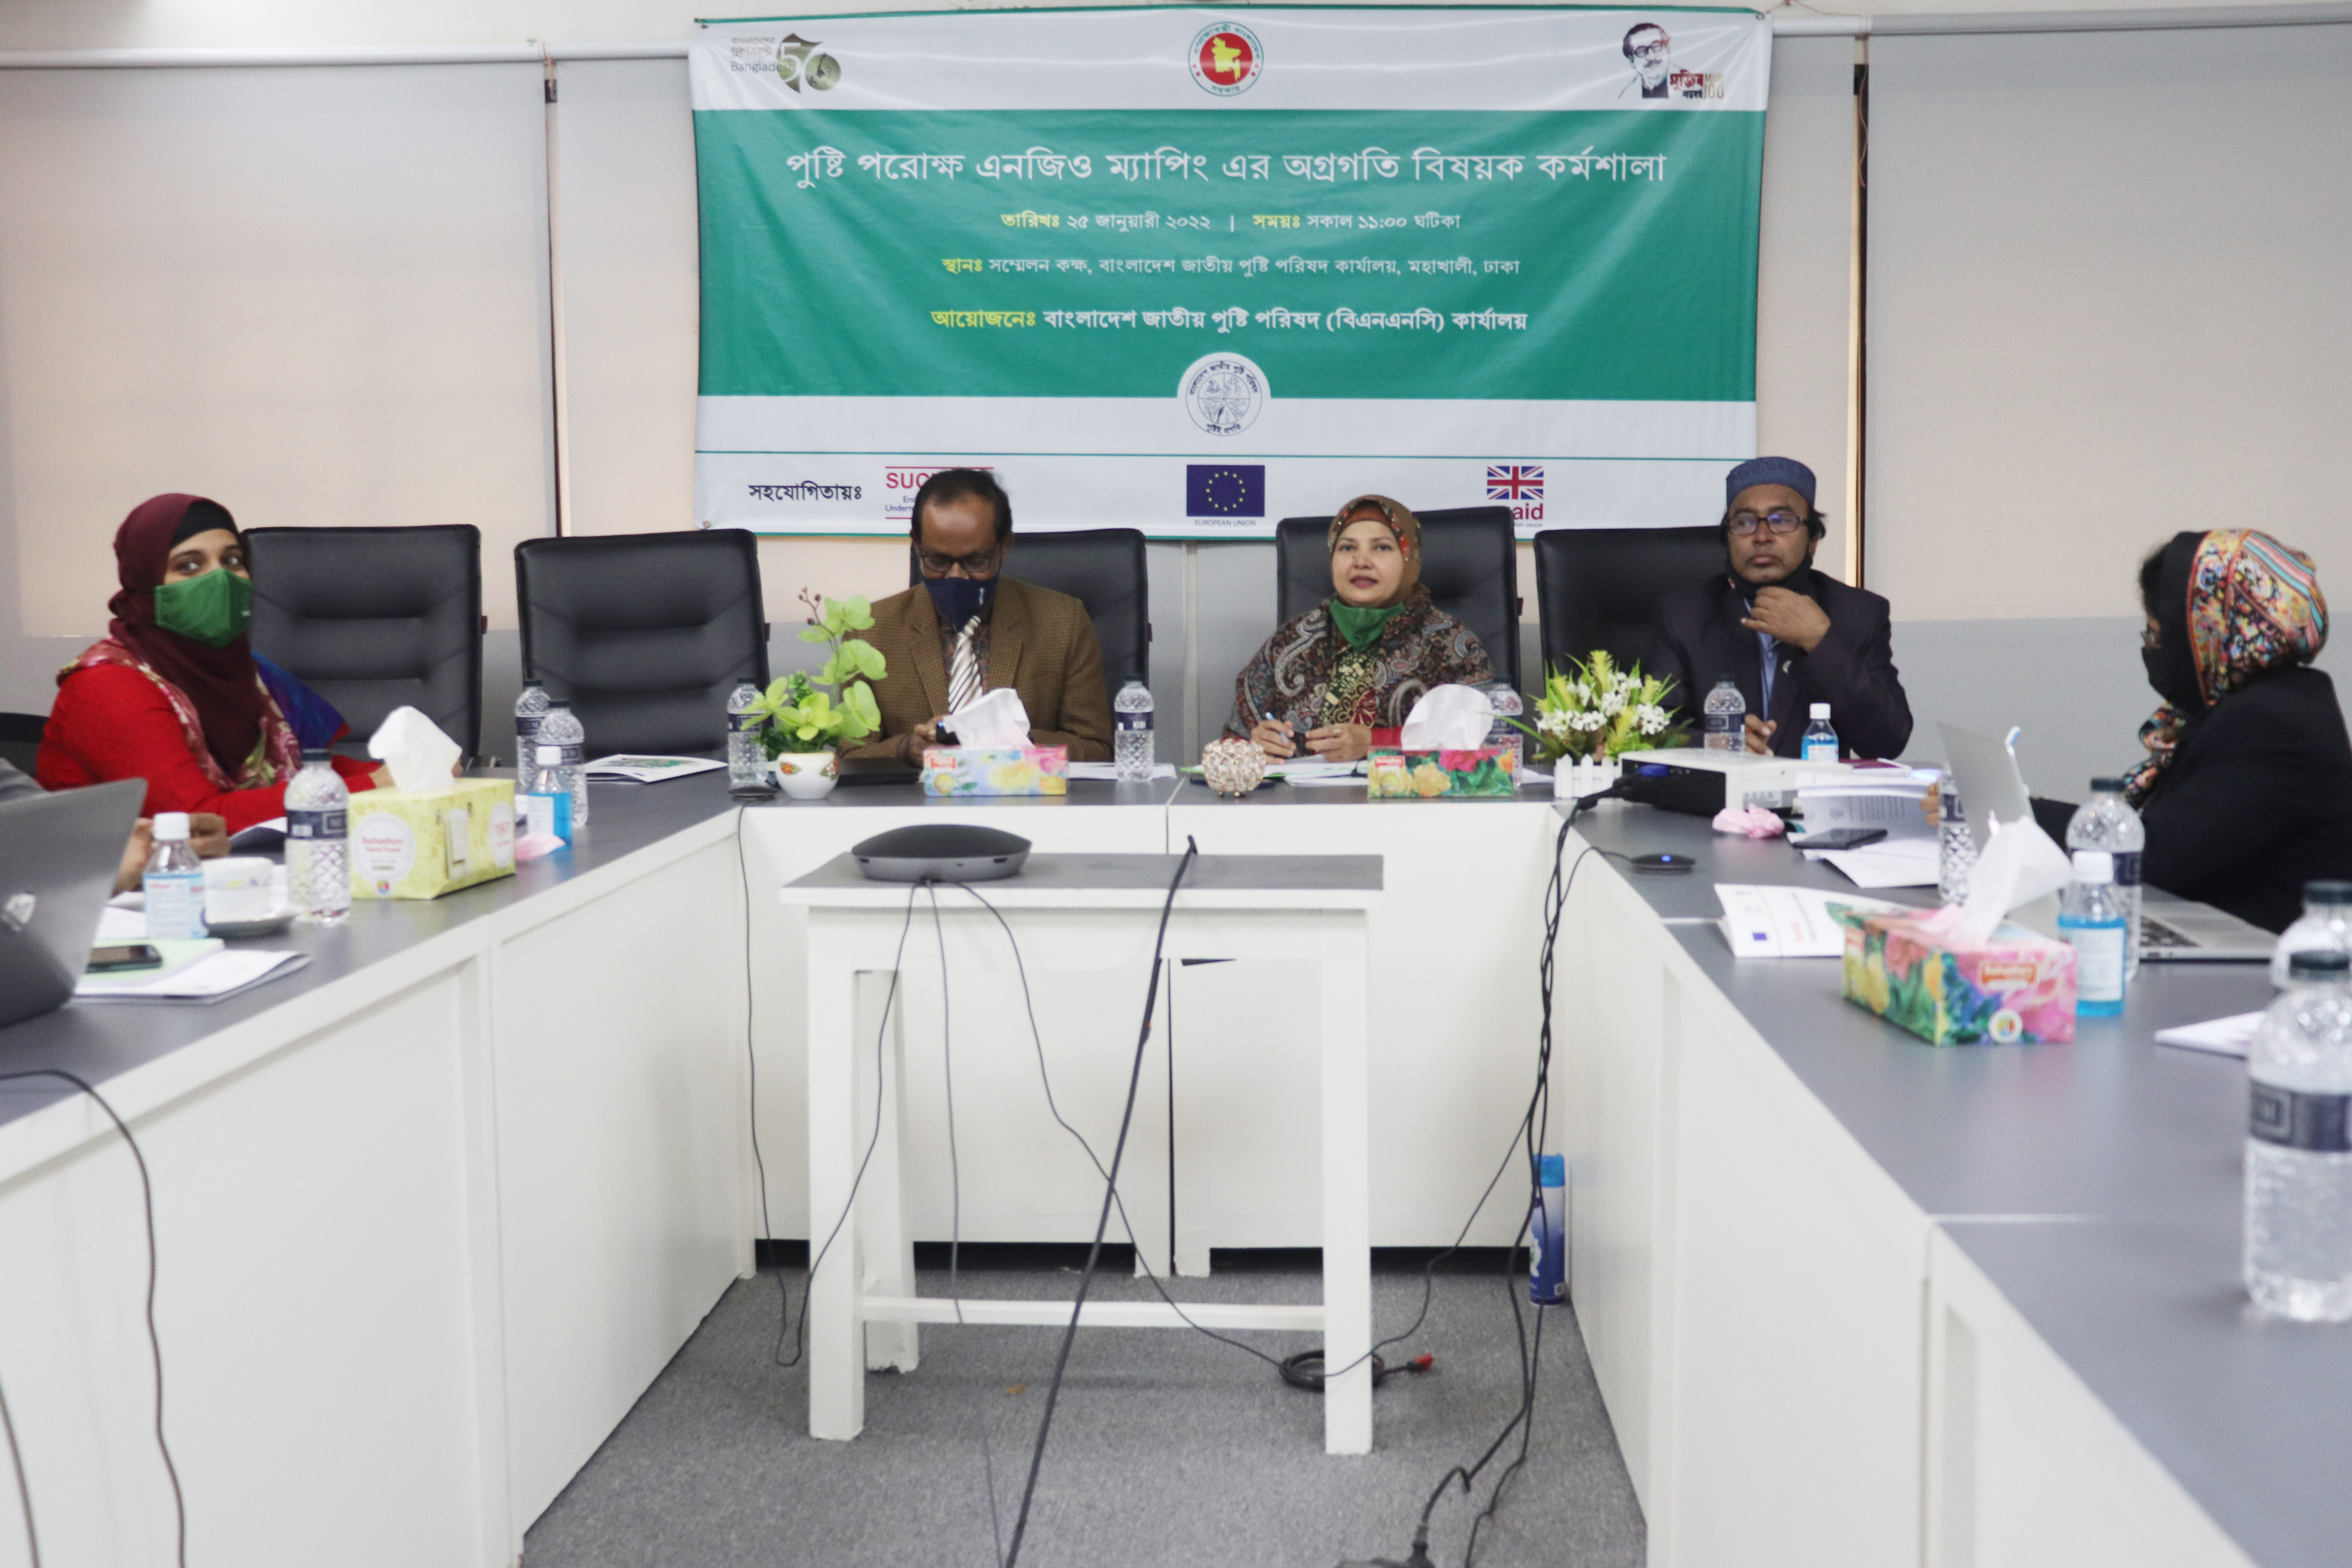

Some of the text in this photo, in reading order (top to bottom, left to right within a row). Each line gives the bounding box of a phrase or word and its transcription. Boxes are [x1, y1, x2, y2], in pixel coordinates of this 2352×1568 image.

[731, 60, 795, 73] Bangladesh
[787, 145, 1668, 189] পুষ্টি পরোক্ষ এনজিও ম্যাপিং এর অগ্রগতি বিষয়ক কর্মশালা
[1001, 210, 1210, 232] তারিখঃ ২৫ জানুয়ারী ২০২২
[1252, 211, 1461, 229] সময়ঃ সকাল ১১:০০ ঘটিকা
[942, 255, 1520, 278] স্থানঃ সম্মেলন কক্ষ, বাংলাদেশ জাতীয় পুষ্টি পরিষদ কার্যালয়, মহাখালী, ঢাকা
[931, 306, 1528, 333] আয়োজনেঃ বাংলাদেশ জাতীয় পুষ্টি পরিষদ (বিএনএনসি) কার্যালয়
[886, 472, 936, 489] SUC
[748, 481, 862, 502] সহযোগিতায়ঃ
[1513, 503, 1543, 519] aid
